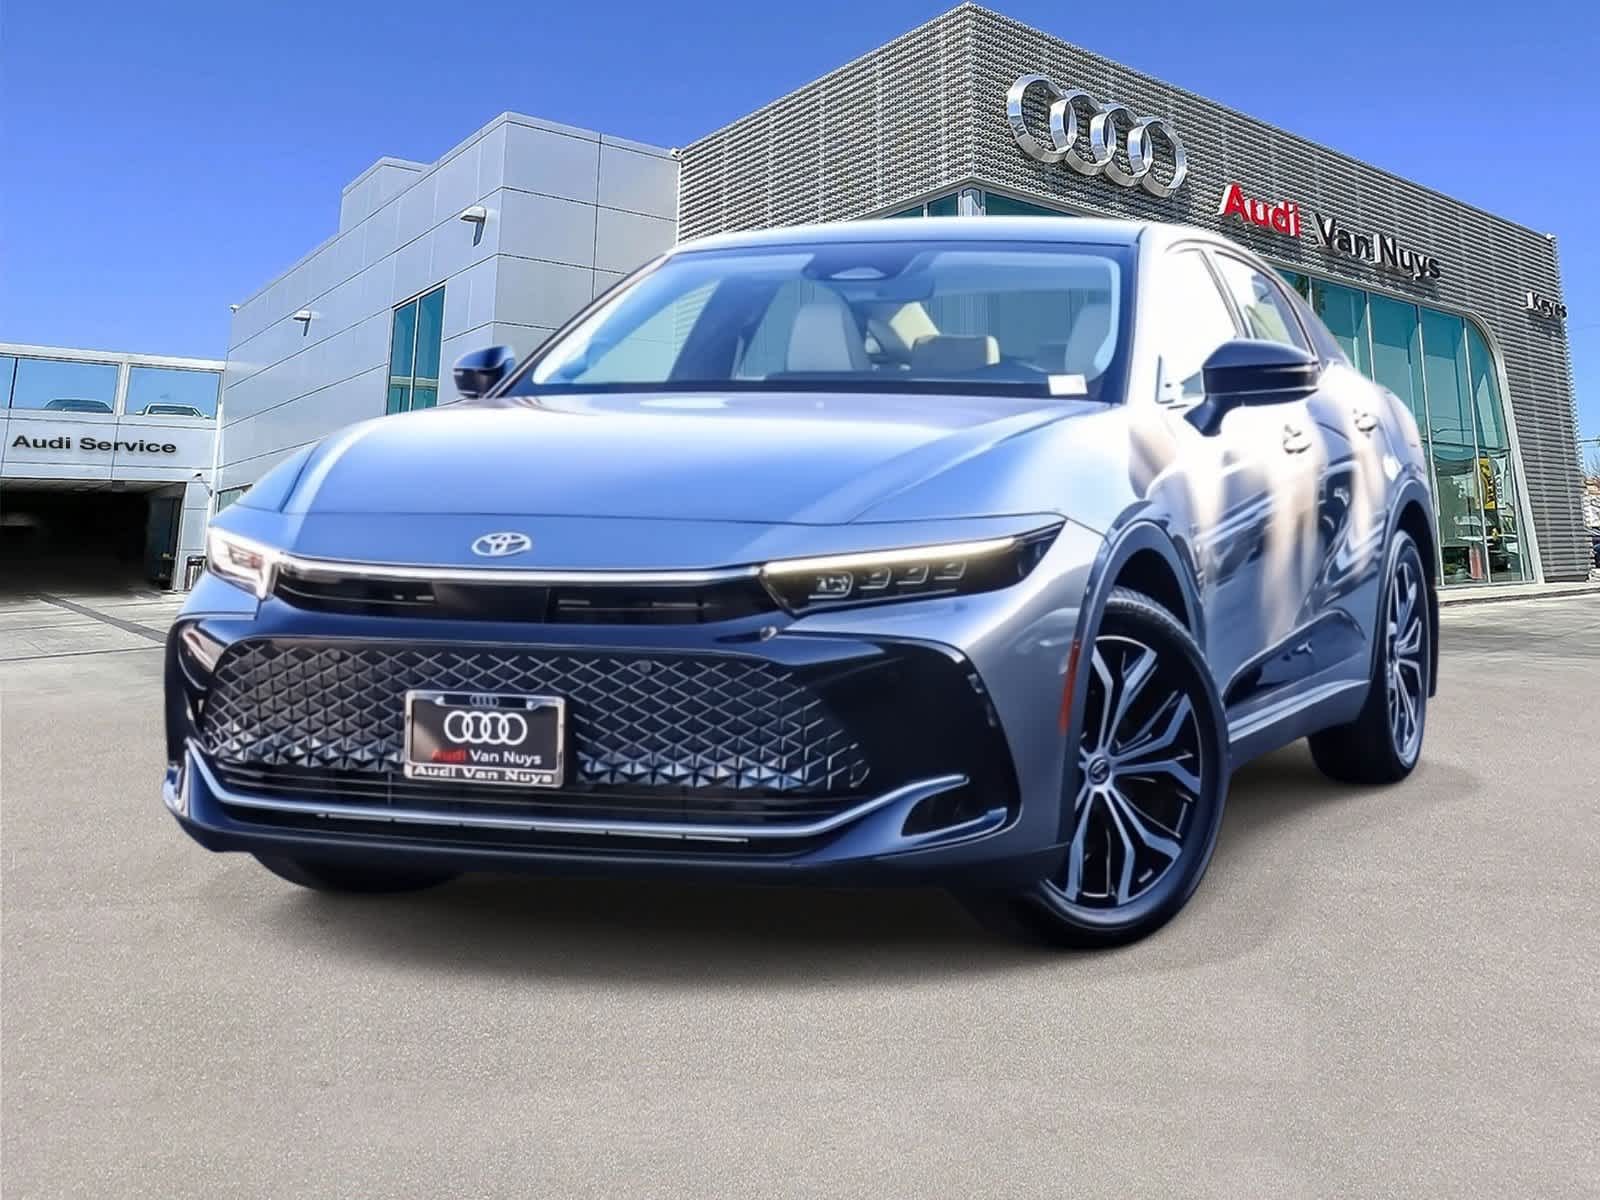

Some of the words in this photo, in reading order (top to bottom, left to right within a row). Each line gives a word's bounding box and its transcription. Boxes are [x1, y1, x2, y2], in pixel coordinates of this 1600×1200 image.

[1218, 182, 1301, 238] Audi
[1311, 213, 1371, 258] Van
[1374, 233, 1441, 280] Nuys
[12, 435, 71, 449] Audi
[79, 437, 177, 454] Service
[469, 749, 499, 763] Van
[503, 751, 542, 767] Nuys
[413, 765, 457, 778] Audi
[463, 767, 499, 780] Van
[504, 770, 553, 784] Nuys
